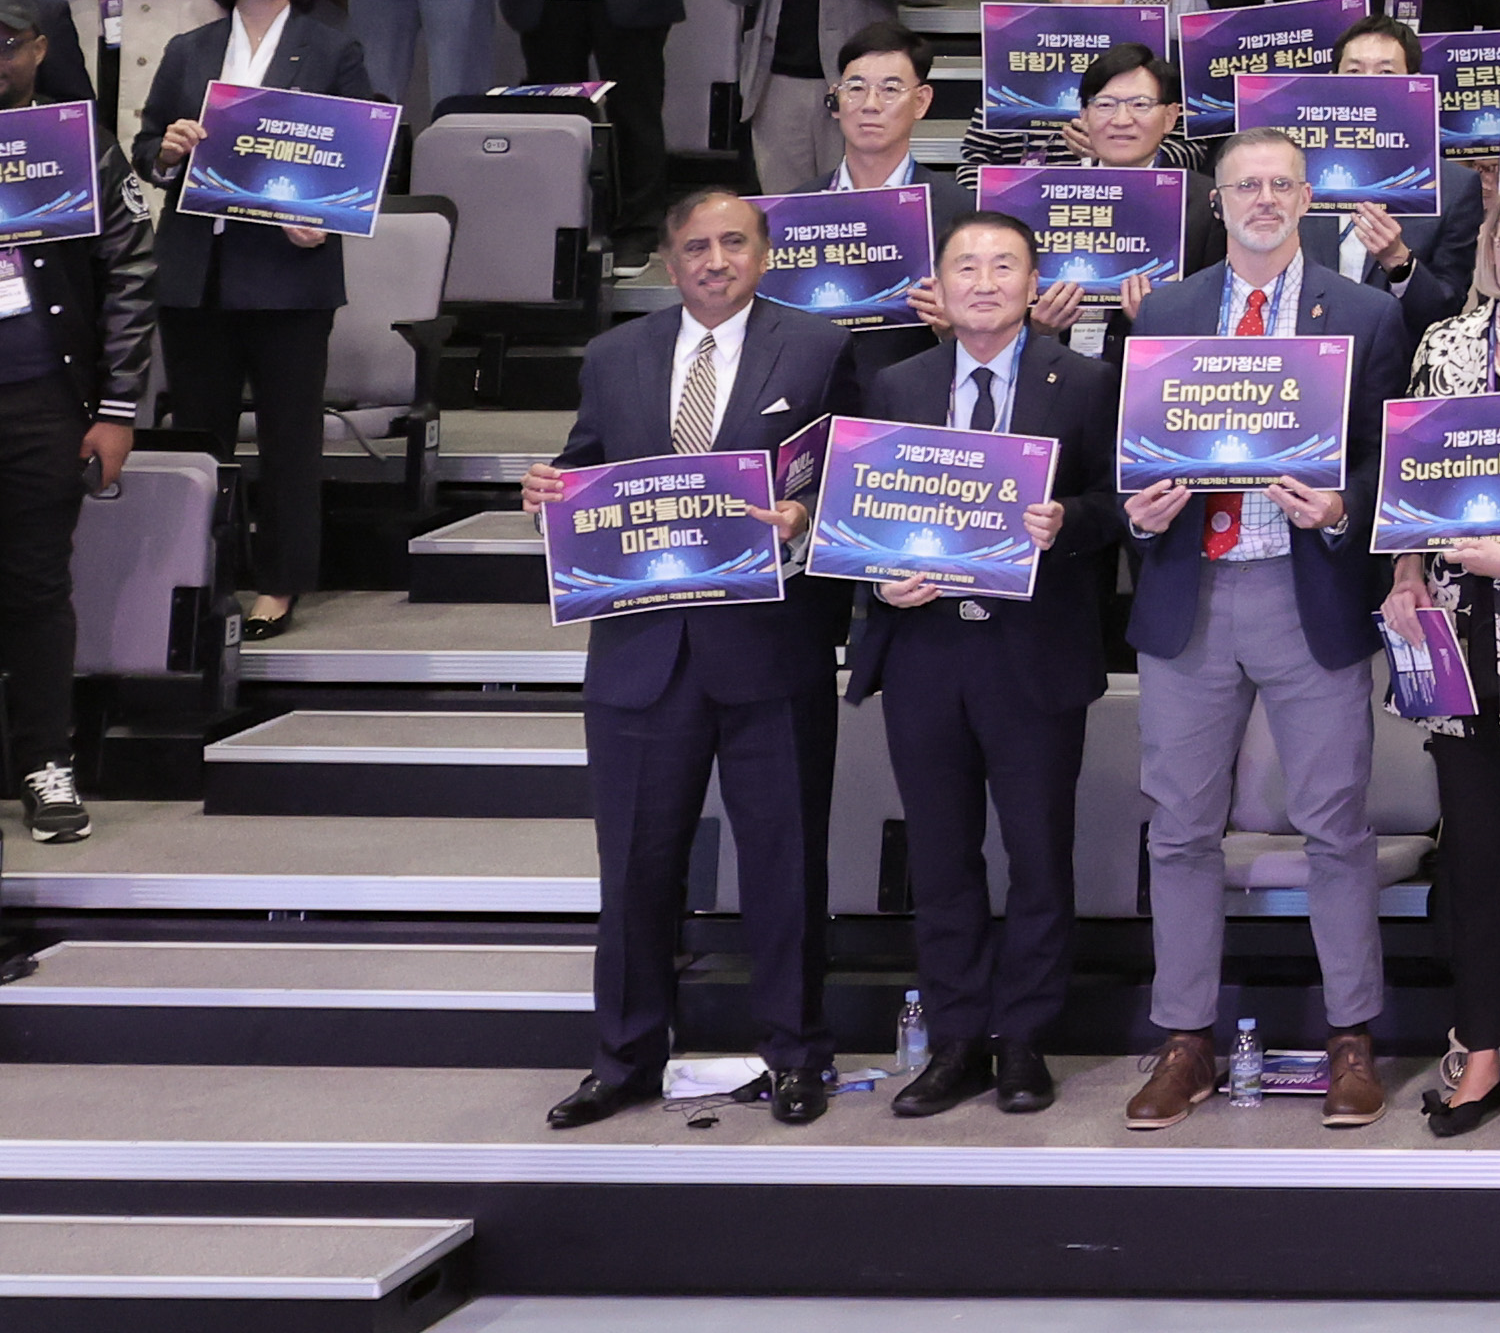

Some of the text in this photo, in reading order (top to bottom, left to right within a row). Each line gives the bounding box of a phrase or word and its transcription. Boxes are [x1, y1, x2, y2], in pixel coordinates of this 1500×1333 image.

[256, 117, 335, 141] 기업가정신은
[232, 135, 345, 168] 우국애민이다.
[1192, 356, 1282, 373] 기업가정신은
[1162, 378, 1300, 406] Empathy &
[1165, 407, 1300, 435] Sharing이다.
[895, 444, 985, 469] 기업가정신은
[613, 473, 706, 498] 기업가정신은
[853, 463, 993, 504] Technology
[998, 478, 1018, 503] &
[572, 504, 623, 534] 함께
[852, 489, 1007, 531] Humanity이다.
[621, 525, 709, 555] 미래이다.
